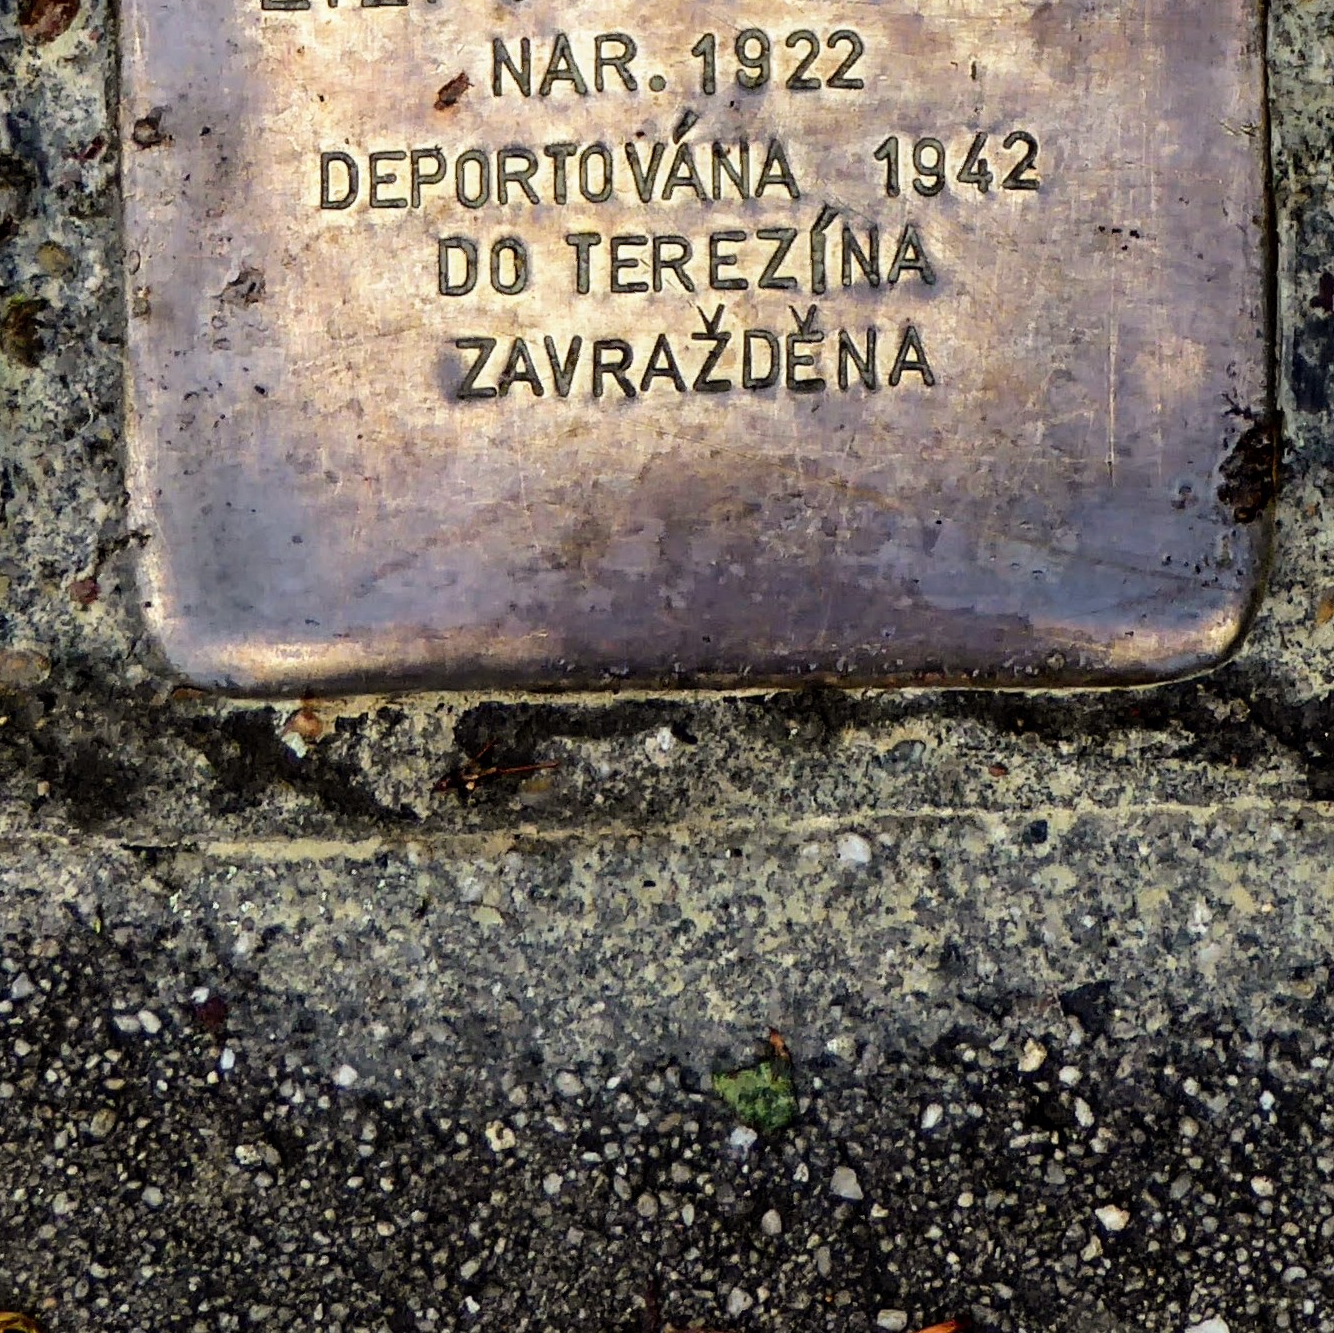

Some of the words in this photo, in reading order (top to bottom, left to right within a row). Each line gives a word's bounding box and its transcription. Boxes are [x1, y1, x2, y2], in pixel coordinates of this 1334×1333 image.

[489, 31, 668, 100] NAR.
[689, 29, 866, 96] 1922
[319, 108, 801, 210] DEPORTOVÁNA
[873, 131, 1043, 198] 1942
[439, 235, 526, 298] DO
[566, 207, 938, 295] TEREZÍNA
[454, 303, 938, 401] ZAVRAŽDĚNA
